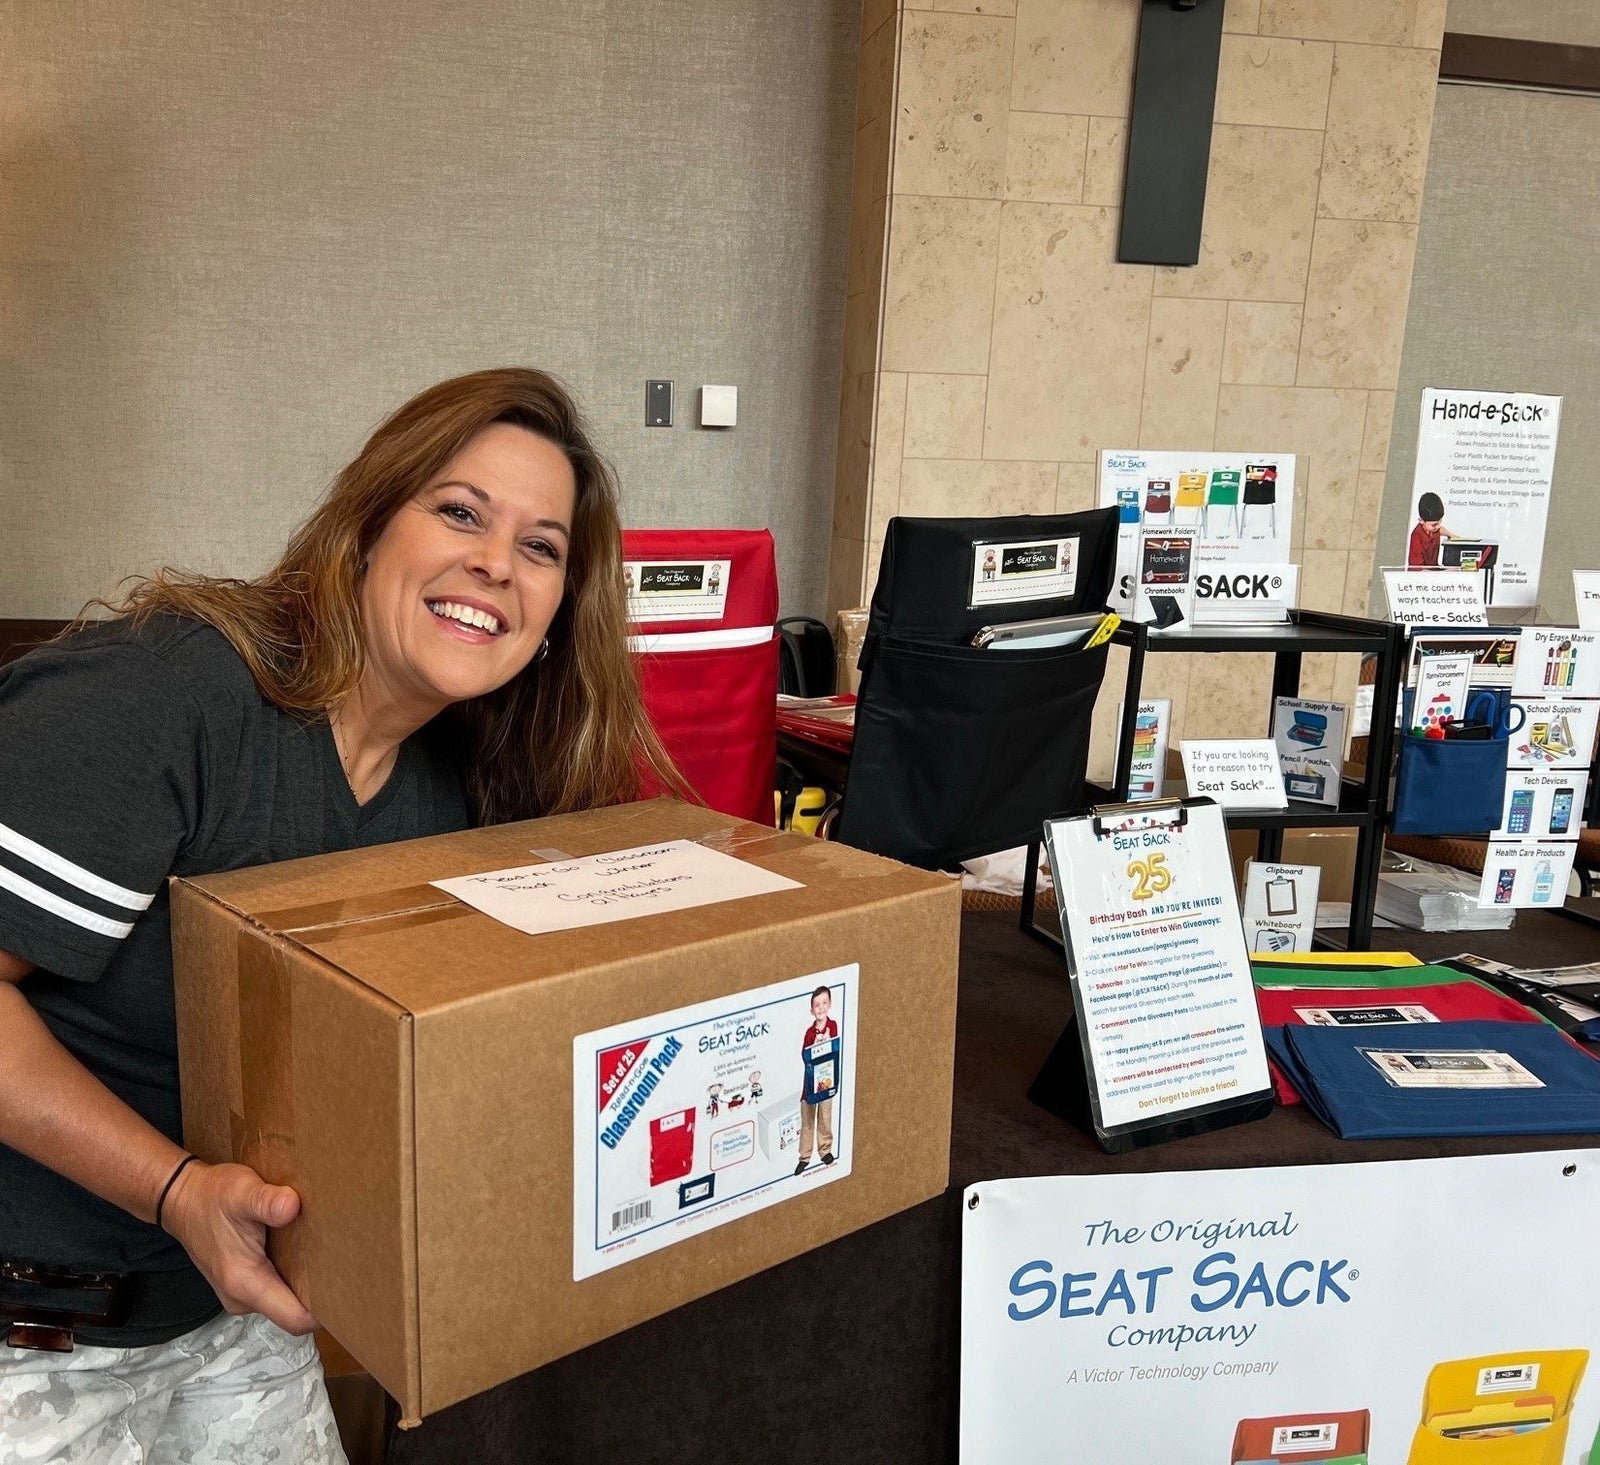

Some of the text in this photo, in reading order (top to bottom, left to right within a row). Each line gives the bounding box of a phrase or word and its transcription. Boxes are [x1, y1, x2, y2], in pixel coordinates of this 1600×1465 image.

[1456, 430, 1501, 439] Specially Designed
[1107, 459, 1126, 468] SEAT
[1142, 527, 1196, 536] Homework Folders
[1017, 554, 1046, 564] SEAT SACK
[1150, 552, 1185, 563] Homework
[656, 574, 673, 583] SEAT
[673, 573, 690, 582] SACK
[1144, 587, 1186, 595] Chromebooks
[1397, 583, 1413, 592] Let
[1431, 584, 1455, 592] count
[1458, 584, 1474, 592] the
[1397, 596, 1419, 605] ways
[1422, 595, 1461, 604] teachers
[1535, 632, 1548, 643] Dry
[1571, 634, 1595, 642] Marker
[1278, 700, 1302, 708] School
[1305, 702, 1328, 711] Supply
[1526, 705, 1582, 714] School Supplies
[1192, 750, 1268, 762] If you are looking
[1280, 754, 1331, 766] Pencil Pouches
[1192, 763, 1207, 773] for
[1247, 763, 1257, 772] to
[1259, 763, 1273, 773] try
[1197, 781, 1224, 792] Seat
[1524, 776, 1568, 785] Tech Devices
[1113, 833, 1171, 850] SEAT SACK
[1495, 849, 1566, 858] Health Care Products
[1127, 852, 1171, 900] 25
[1266, 866, 1303, 875] Clipboard
[1089, 896, 1222, 925] Birthday Bash AND YOU'RE INVITED!
[1092, 933, 1115, 943] Here's
[1116, 931, 1132, 941] How
[1133, 929, 1141, 938] to
[1141, 926, 1159, 936] Enter
[1167, 922, 1182, 932] Win
[1182, 917, 1222, 929] Giveaways:
[1255, 920, 1302, 928] Whiteboard
[1114, 963, 1129, 971] Enter
[1137, 960, 1147, 968] Win
[1154, 957, 1173, 965] register
[1096, 980, 1123, 990] Subscribe
[1140, 972, 1168, 982] Instagram
[1169, 969, 1182, 977] Page
[1090, 993, 1117, 1003] Facebook
[1117, 991, 1132, 1000] page
[1198, 975, 1214, 983] month
[1221, 971, 1233, 979] June
[1092, 994, 1181, 1016] watch several each
[1101, 1019, 1129, 1029] Comment
[1147, 1010, 1173, 1021] Giveaway
[1174, 1007, 1188, 1015] Posts
[1203, 1000, 1223, 1009] included
[699, 1022, 770, 1053] SEAT SACK
[1130, 1042, 1152, 1052] evening
[1191, 1029, 1216, 1039] announce
[1225, 1023, 1245, 1032] winners
[1125, 1057, 1148, 1066] Monday
[1148, 1051, 1171, 1061] morning
[1210, 1038, 1231, 1048] previous
[602, 1048, 636, 1095] Set of 25
[1112, 1073, 1136, 1083] Winners
[1137, 1070, 1146, 1078] will
[1155, 1063, 1182, 1074] contacted
[1182, 1061, 1190, 1069] by
[1190, 1057, 1205, 1067] email
[1205, 1054, 1224, 1063] through
[1234, 1048, 1248, 1057] email
[1106, 1088, 1129, 1098] address
[1153, 1080, 1166, 1088] used
[1174, 1073, 1194, 1085] sign-up
[1211, 1065, 1235, 1076] giveaway
[600, 1071, 661, 1150] Classroom
[650, 1034, 685, 1076] Pack
[1138, 1096, 1158, 1109] Don't
[1159, 1091, 1180, 1104] forget
[1190, 1087, 1209, 1097] invite
[1215, 1079, 1238, 1092] friend!
[1084, 1211, 1298, 1249] The Original
[1007, 1260, 1173, 1321] SEAT
[1107, 1321, 1257, 1352] Company
[1067, 1359, 1278, 1384] A Victor Technology Company
